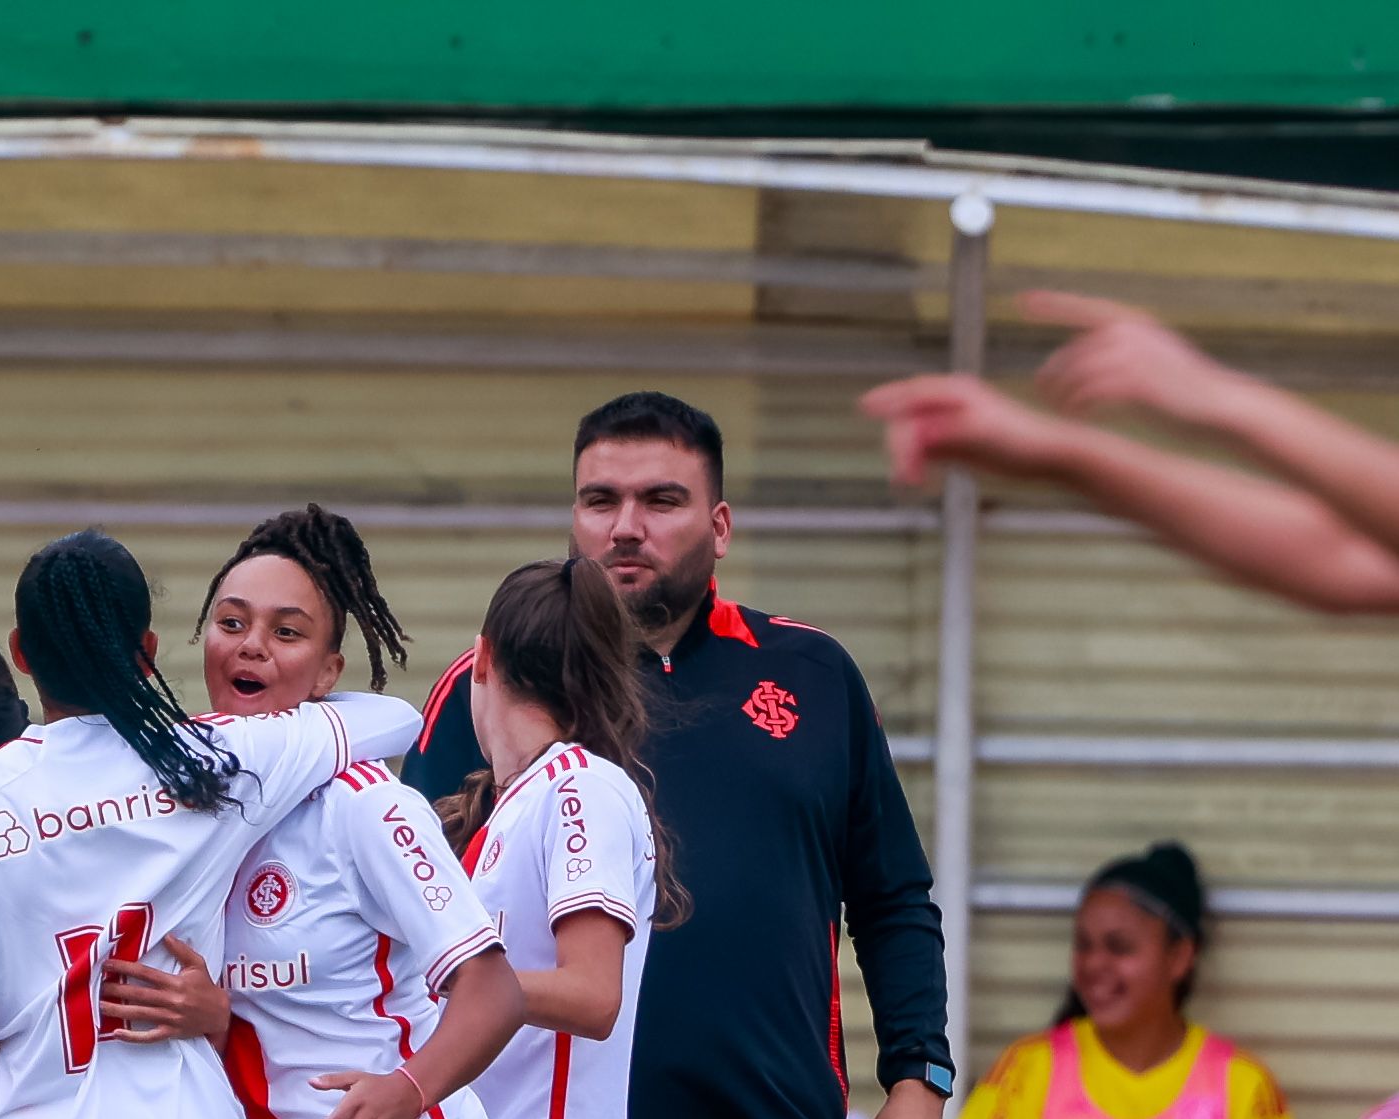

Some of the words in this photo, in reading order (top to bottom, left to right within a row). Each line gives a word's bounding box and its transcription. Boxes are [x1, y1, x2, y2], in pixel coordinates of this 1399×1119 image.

[382, 803, 435, 882] vero
[558, 775, 588, 854] vero
[55, 901, 154, 1075] 11
